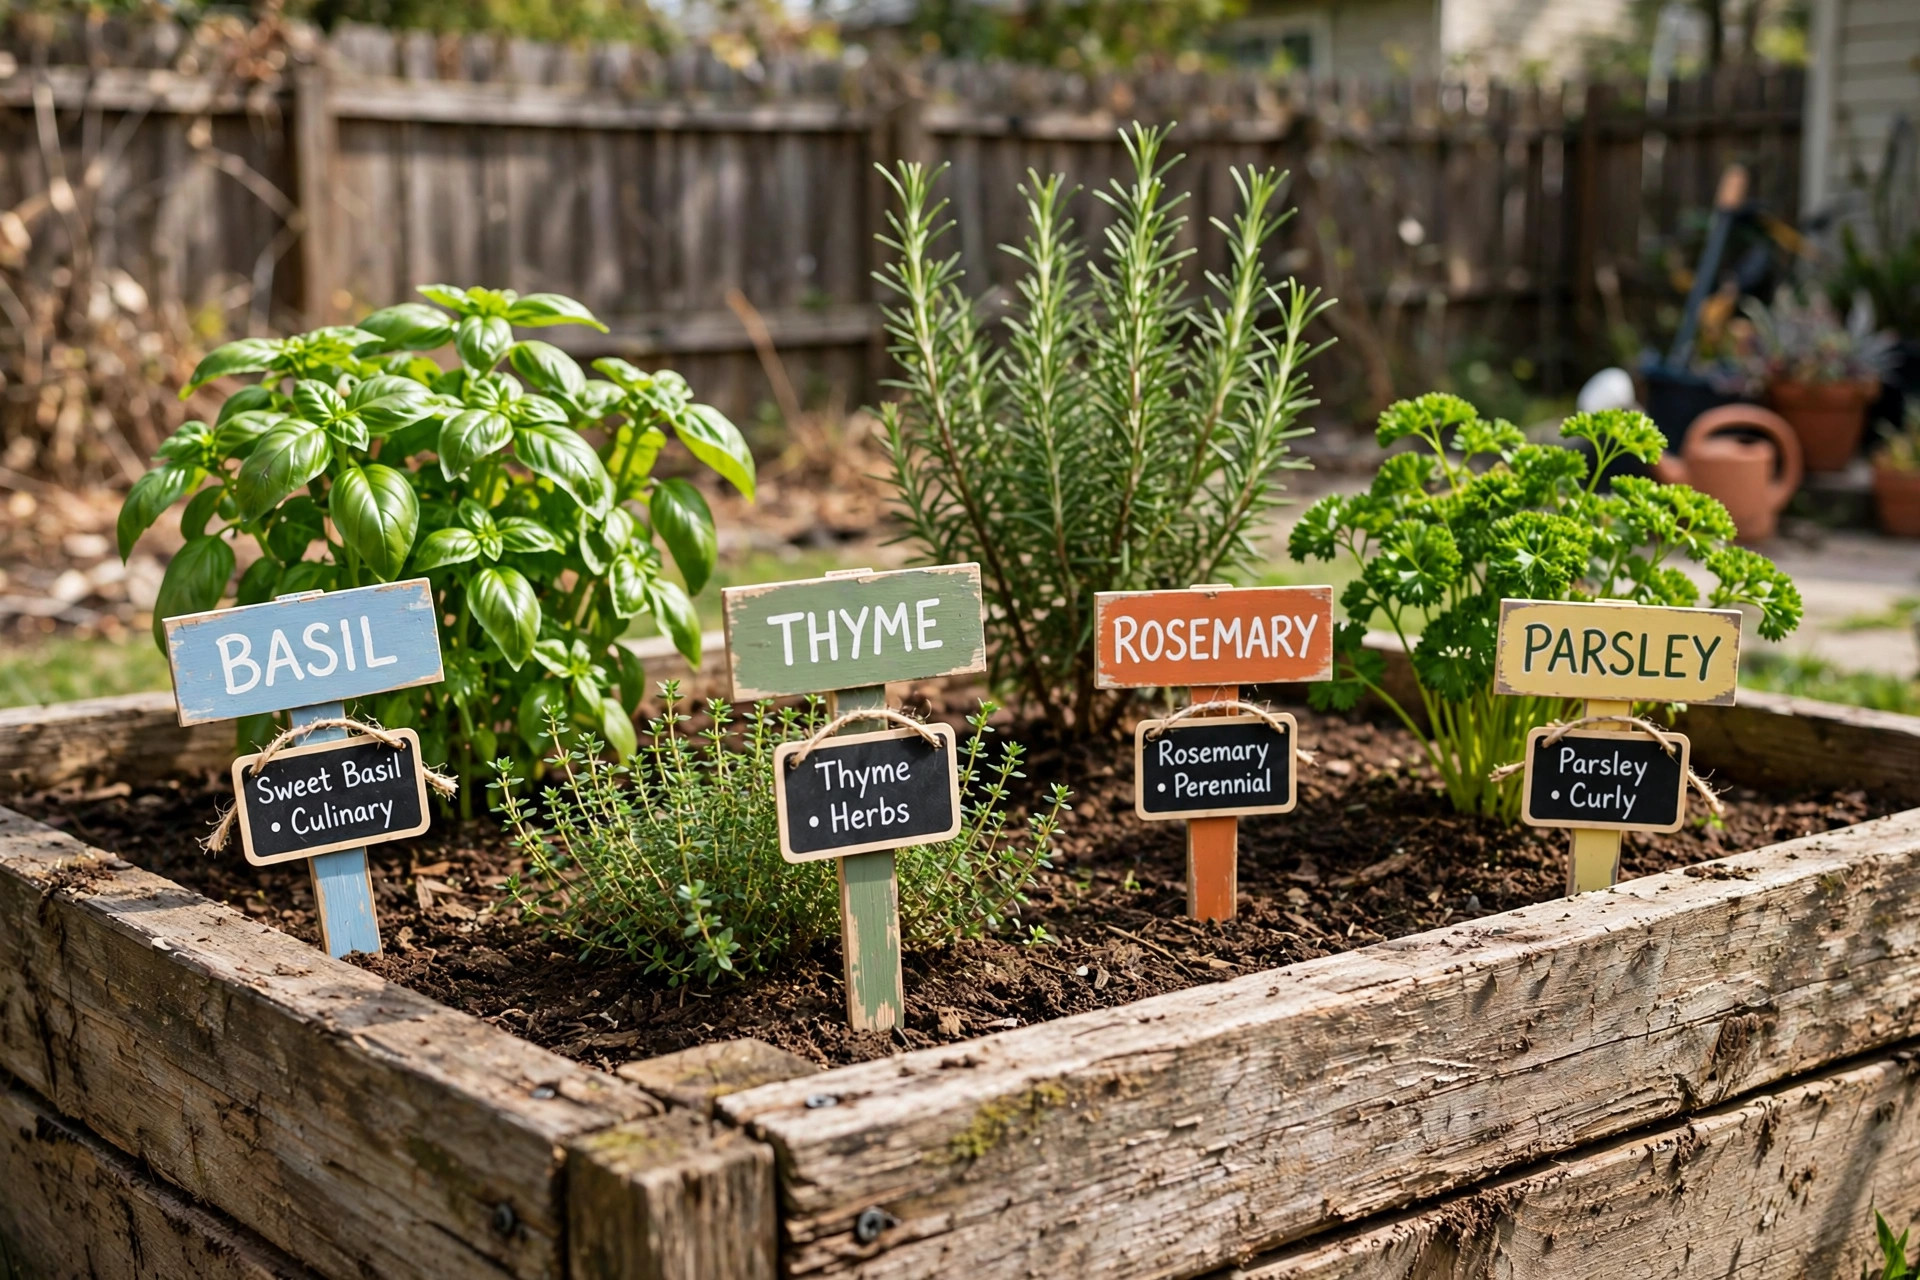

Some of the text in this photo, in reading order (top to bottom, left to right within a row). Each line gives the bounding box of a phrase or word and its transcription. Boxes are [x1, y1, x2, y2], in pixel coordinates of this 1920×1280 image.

[766, 598, 943, 666] THYME
[1113, 614, 1318, 664] ROSEMARY
[215, 615, 398, 695] BASIL
[1523, 623, 1721, 681] PARSLEY
[1158, 739, 1269, 769] Rosemary
[1559, 747, 1648, 787] Parsley
[256, 752, 401, 804] Sweet Basil
[814, 759, 911, 798] Thyme
[1174, 768, 1271, 798] Perennial
[291, 800, 393, 835] Culinary
[830, 797, 910, 834] Herbs
[1569, 782, 1637, 820] Curly
